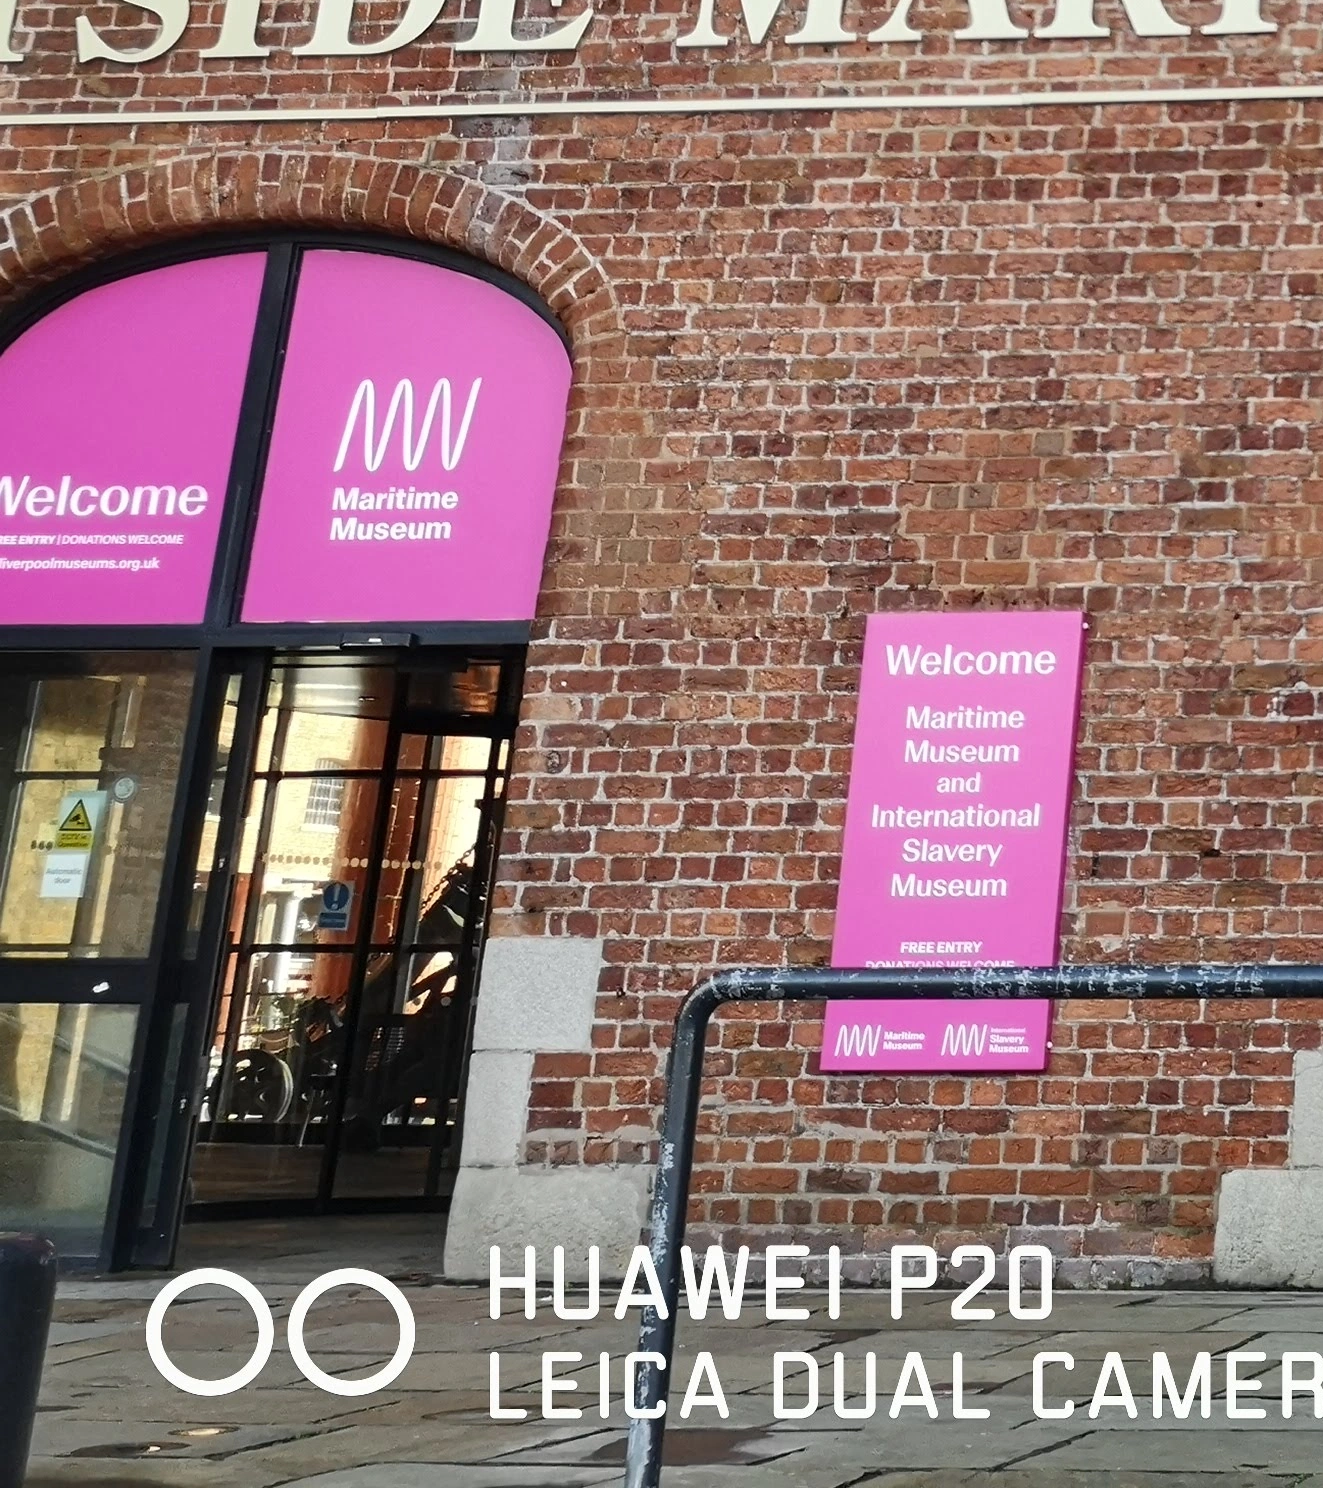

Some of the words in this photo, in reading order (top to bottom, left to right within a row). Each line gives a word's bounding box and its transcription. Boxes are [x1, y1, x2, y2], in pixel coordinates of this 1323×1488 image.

[332, 487, 458, 510] Maritime
[19, 535, 56, 544] ENTRY
[62, 535, 127, 544] DONATIONS
[128, 535, 184, 544] WELCOME
[330, 517, 451, 540] Museum
[886, 644, 1056, 675] Welcome
[906, 706, 1025, 729] Maritime
[905, 740, 1019, 762] Museum
[937, 772, 981, 793] and
[872, 803, 1040, 828] International
[902, 838, 1002, 866] Slavery
[891, 874, 1006, 897] Museum
[901, 942, 935, 953] FREE
[937, 942, 982, 953] ENTRY
[883, 1032, 925, 1041] Maritime
[883, 1041, 922, 1050] Museum
[990, 1034, 1024, 1046] Slavery
[989, 1045, 1029, 1053] Museum
